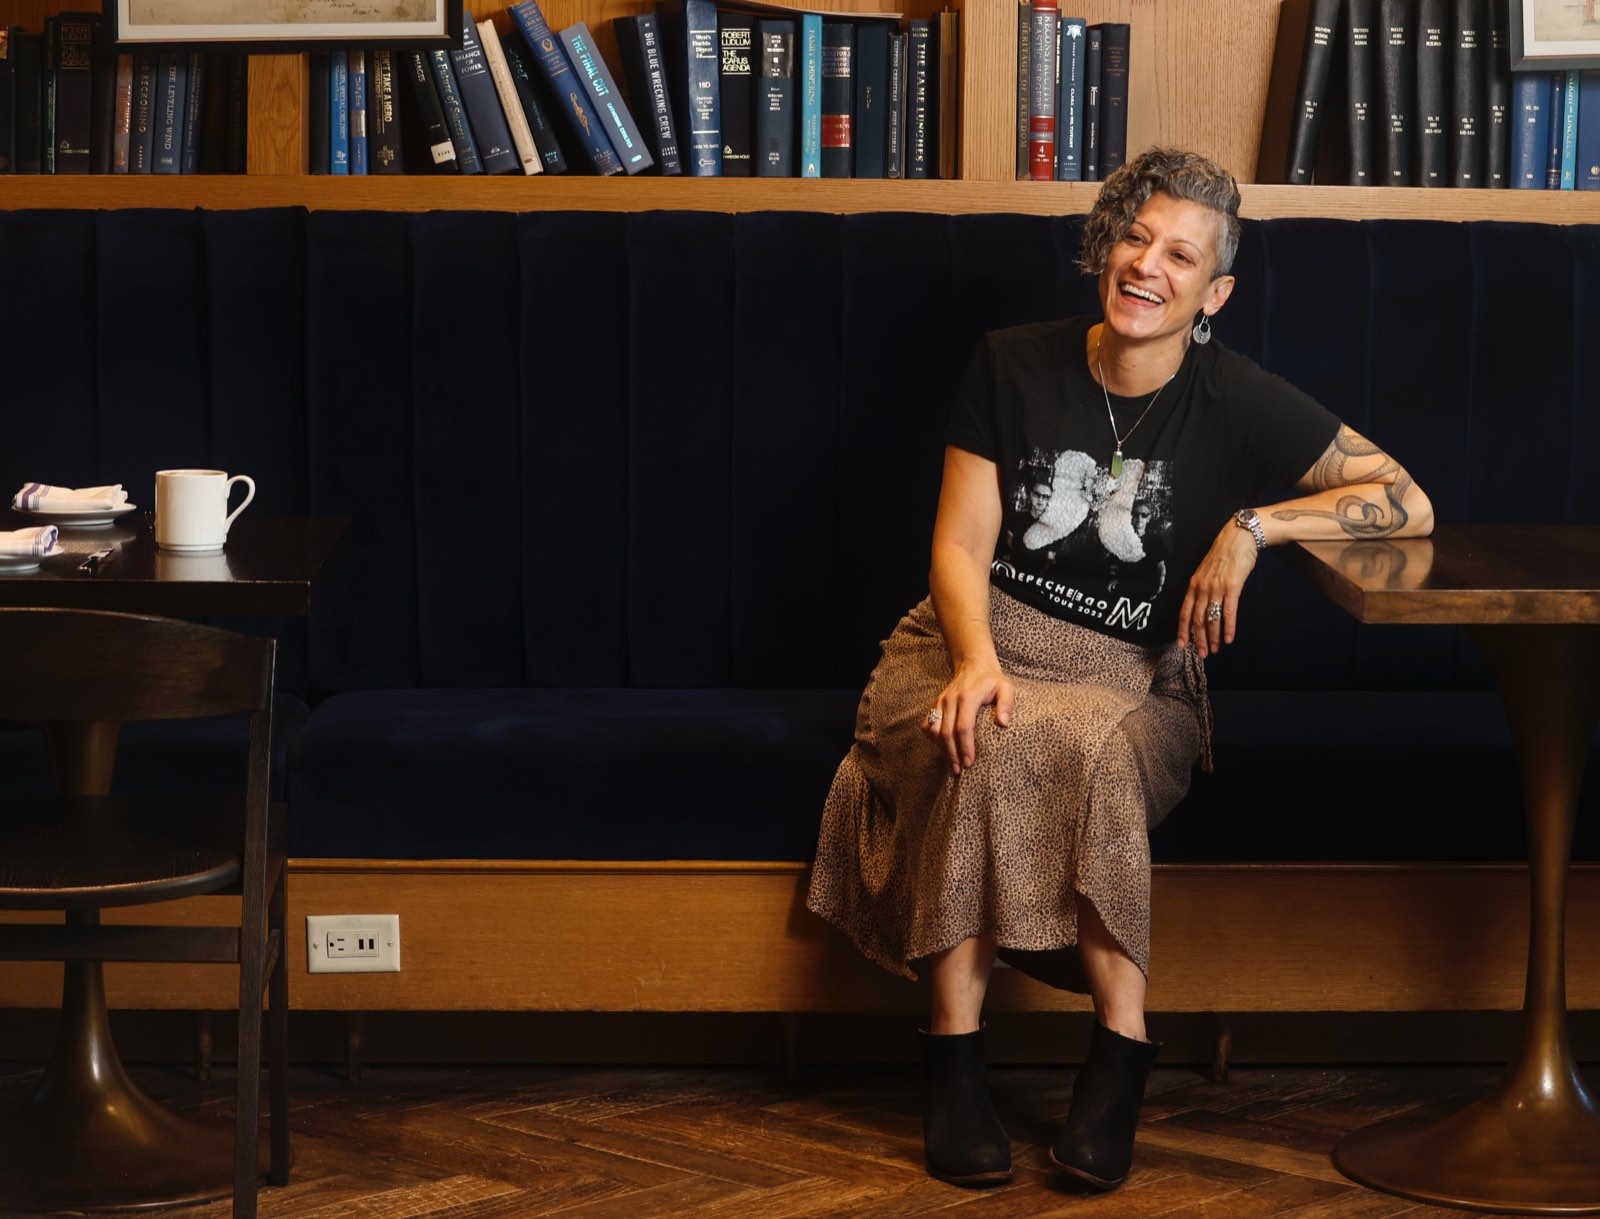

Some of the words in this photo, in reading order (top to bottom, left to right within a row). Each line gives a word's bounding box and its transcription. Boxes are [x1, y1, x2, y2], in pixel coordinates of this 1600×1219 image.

[571, 34, 588, 55] THE
[644, 32, 655, 46] BIG
[808, 30, 816, 57] FAMILY
[1034, 16, 1044, 59] PLASTIC
[434, 50, 444, 62] he
[455, 51, 481, 62] BALANCE
[579, 54, 601, 80] FINAL
[647, 48, 660, 70] BLUE
[722, 57, 748, 65] ICARUS
[917, 42, 926, 68] THE
[1044, 16, 1053, 111] RECONSTRUCTIVE
[437, 63, 452, 93] Future
[461, 64, 483, 74] POWER
[808, 58, 816, 106] WHISPERING
[383, 72, 392, 94] TAKE
[592, 78, 609, 97] CUT
[650, 70, 668, 113] WRECKING
[916, 70, 926, 104] FAME
[1021, 78, 1028, 92] OF
[1034, 62, 1043, 109] SURGERY
[139, 74, 149, 133] RECKONING
[166, 85, 175, 125] LEVELING
[384, 102, 393, 122] HERO
[447, 95, 459, 106] of
[450, 107, 466, 142] Success
[606, 102, 622, 128] CATHERINE
[616, 126, 634, 149] COULTER
[658, 115, 672, 140] CREW
[915, 107, 925, 162] LUNCHES
[164, 127, 173, 150] WIND
[1039, 145, 1044, 153] 4
[1048, 593, 1074, 609] TOUR
[1076, 605, 1104, 619] 2023
